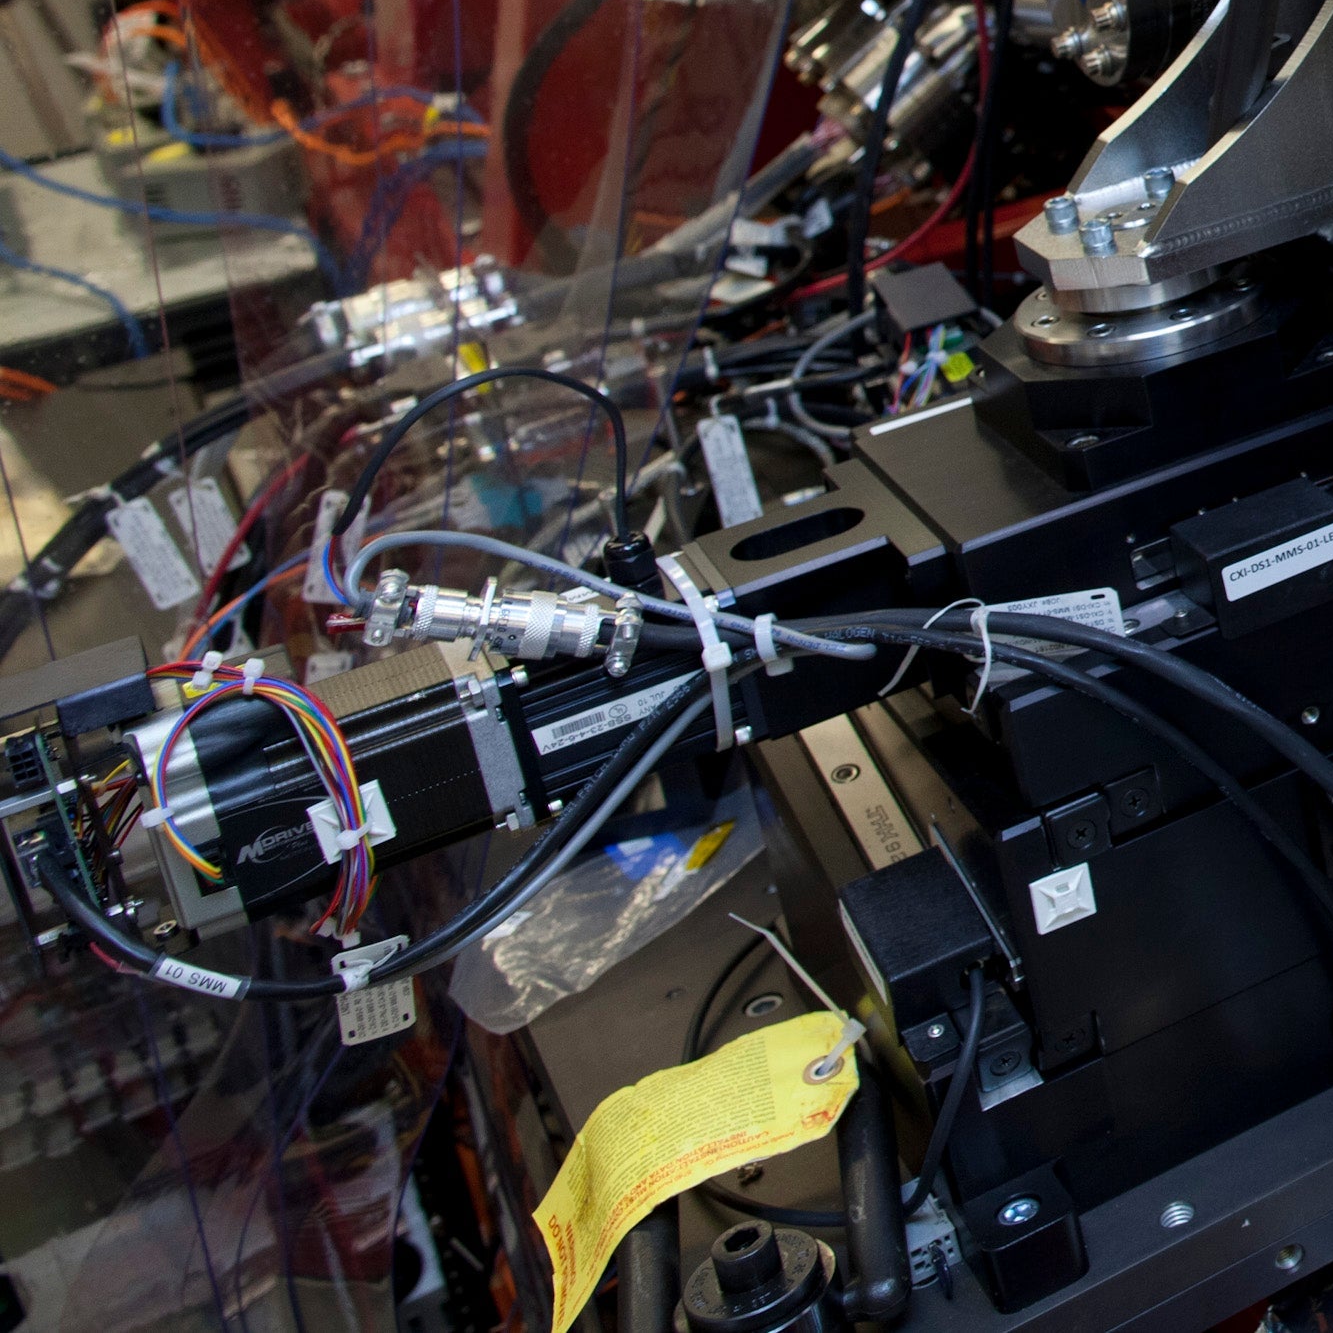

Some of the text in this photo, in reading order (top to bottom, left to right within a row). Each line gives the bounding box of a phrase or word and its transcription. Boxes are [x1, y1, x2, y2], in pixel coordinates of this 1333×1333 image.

[637, 698, 648, 708] 10
[648, 691, 667, 704] JUL
[164, 964, 228, 994] MMS 01
[548, 1213, 561, 1238] DO
